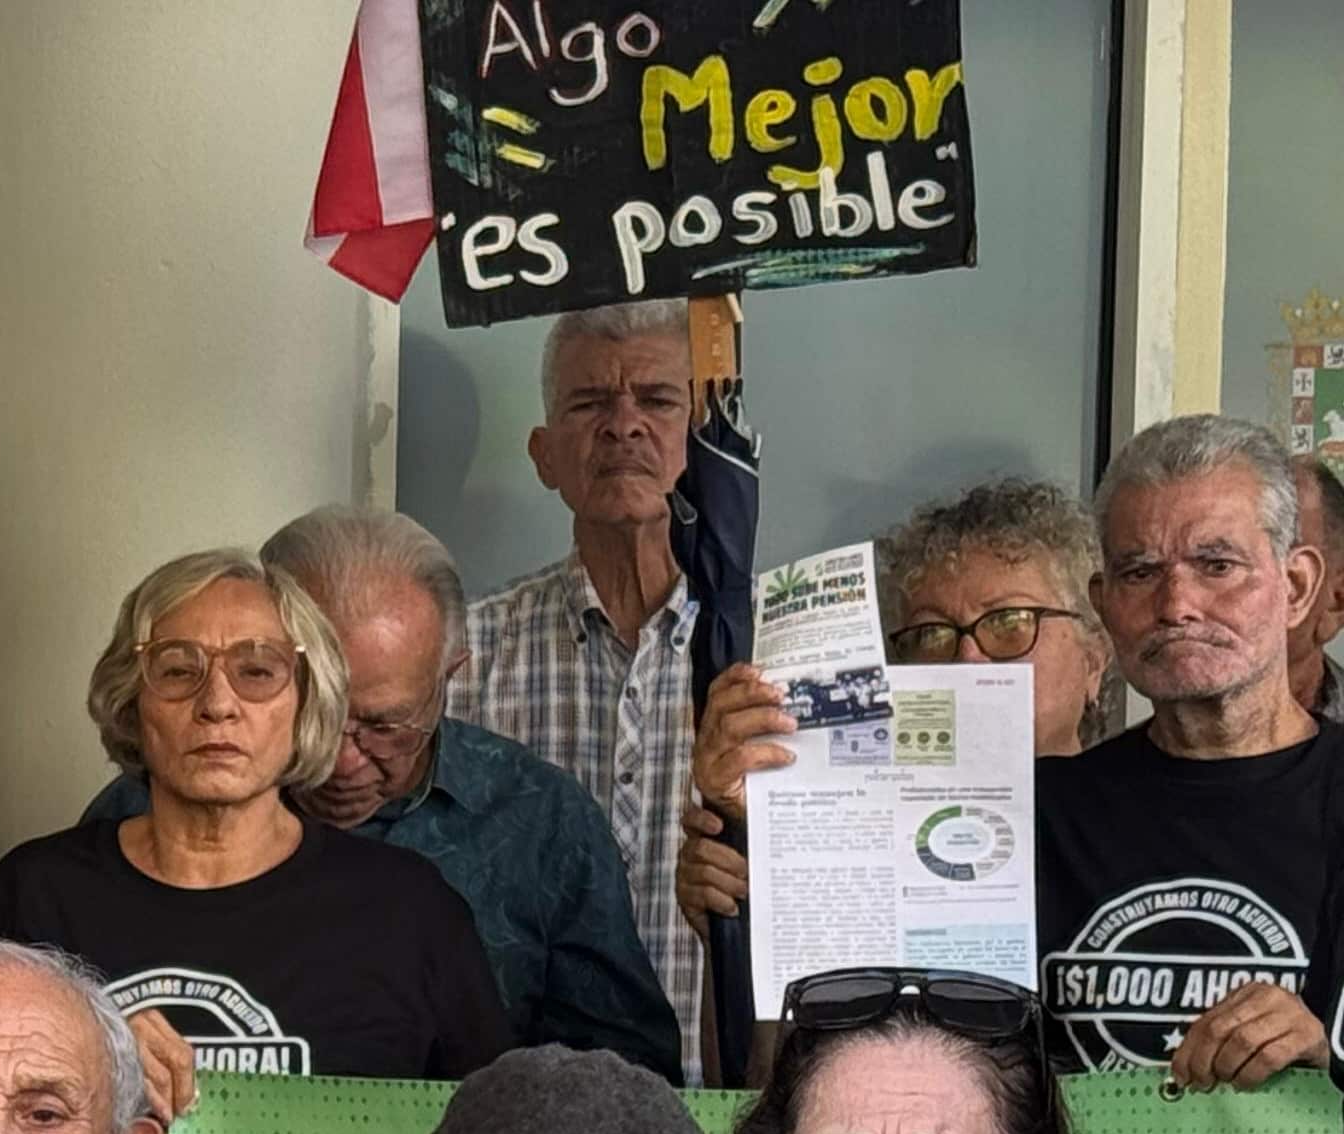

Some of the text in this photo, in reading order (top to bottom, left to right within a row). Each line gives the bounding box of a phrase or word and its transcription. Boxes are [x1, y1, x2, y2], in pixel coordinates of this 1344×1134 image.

[481, 0, 660, 105] Algo
[641, 55, 962, 189] Mejor
[1201, 891, 1240, 912] OTRO
